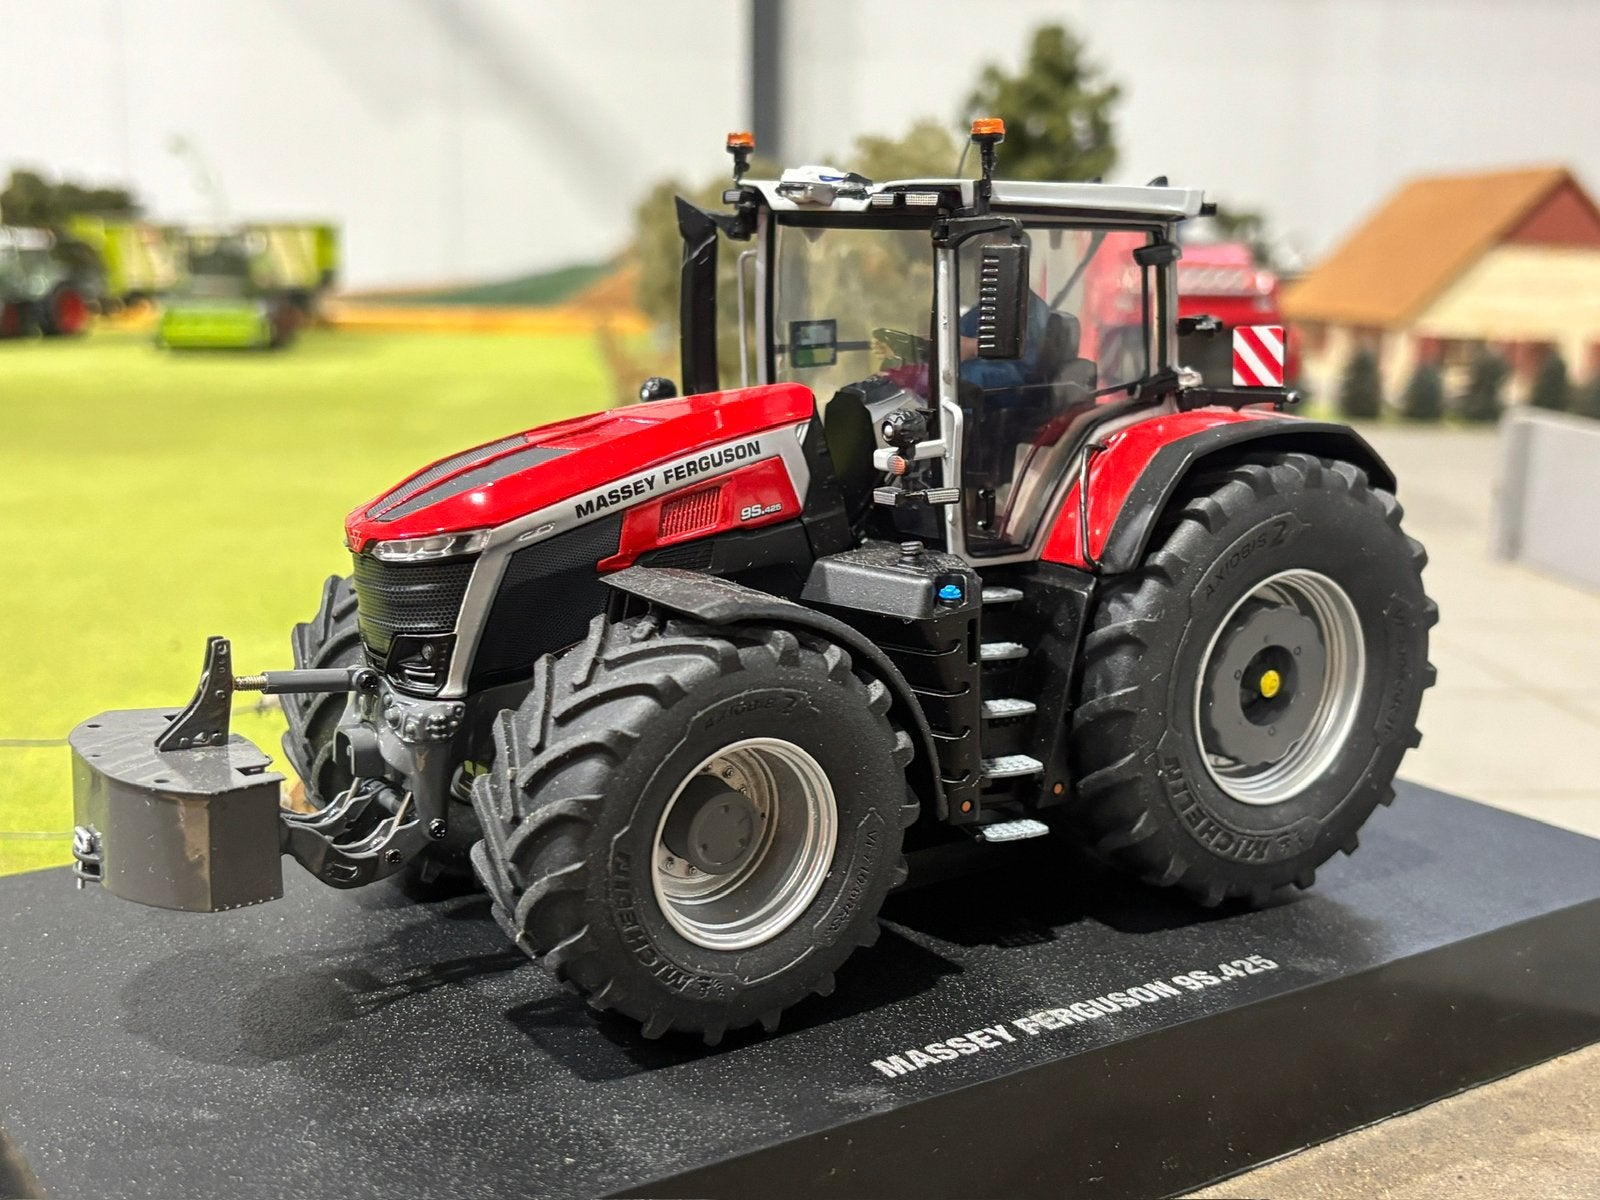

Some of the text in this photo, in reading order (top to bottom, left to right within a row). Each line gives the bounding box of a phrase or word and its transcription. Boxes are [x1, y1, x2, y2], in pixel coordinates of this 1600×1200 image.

[575, 440, 761, 519] MASSEY FERGUSON
[741, 503, 782, 520] 9S.425
[1163, 756, 1270, 862] MICHELIN
[613, 851, 696, 992] MICHELIN
[870, 954, 1280, 1078] MASSEY FERGUSON 9S.425
